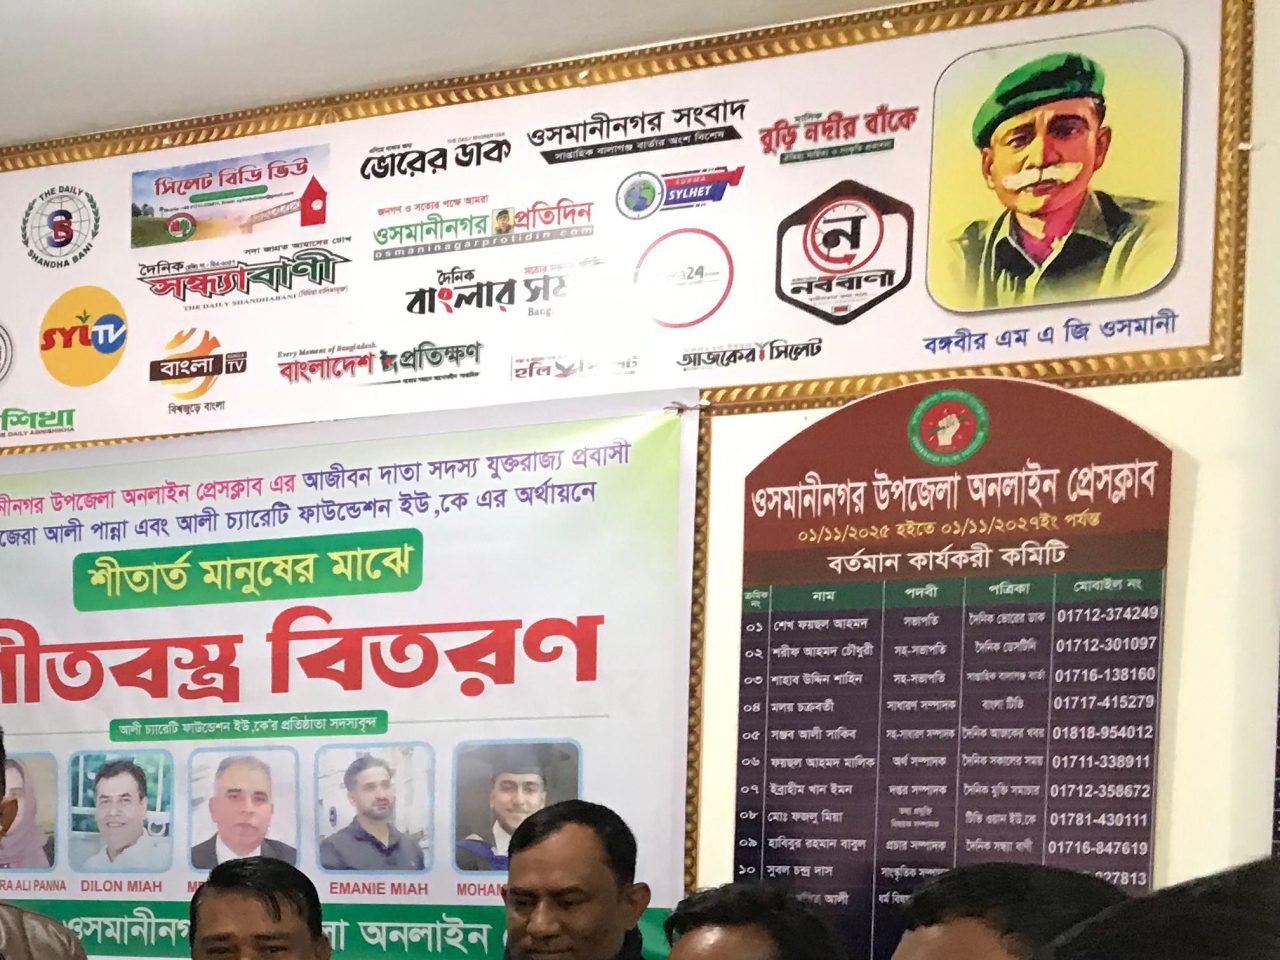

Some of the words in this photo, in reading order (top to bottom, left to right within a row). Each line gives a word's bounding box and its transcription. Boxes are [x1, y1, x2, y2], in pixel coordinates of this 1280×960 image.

[527, 111, 665, 147] ওসমানীনগর
[672, 99, 749, 128] সংবাদ
[804, 110, 859, 142] নদীর
[360, 147, 448, 180] ভোরের
[454, 139, 512, 167] ডাক
[155, 172, 213, 195] সিলেট
[217, 164, 262, 187] বিডি
[39, 187, 56, 201] THE
[59, 185, 83, 197] DAILY
[668, 185, 713, 201] SYLHET
[373, 212, 490, 246] ওসমানীনগর
[513, 198, 595, 231] প্রতিদিন
[822, 215, 867, 250] ন
[28, 249, 70, 268] SHANDHA
[72, 243, 94, 263] BANI
[139, 261, 185, 277] দৈনিক
[437, 266, 476, 285] দৈনিক
[406, 278, 518, 314] বাংলার
[923, 329, 987, 355] বঙ্গবীর
[994, 327, 1029, 349] এম
[1037, 326, 1055, 345] এ
[1063, 318, 1092, 342] জি
[1100, 308, 1179, 338] ওসমানী
[769, 337, 823, 360] সিলেট
[159, 357, 216, 377] বাংলা
[227, 360, 244, 372] TV
[277, 352, 377, 386] বাংলাদেশ
[50, 489, 117, 511] উপজেলা
[121, 481, 191, 507] অনলাইন
[197, 476, 264, 500] প্রেসক্লাব
[270, 474, 296, 494] এর
[302, 462, 372, 490] আজীবন
[378, 462, 421, 484] দাতা
[428, 457, 480, 482] সদস্য
[485, 449, 565, 482] যুক্তরাজ্য
[571, 438, 632, 468] প্রবাসী
[751, 470, 867, 520] ওসমানীনগর
[871, 468, 962, 514] উপজেলা
[966, 458, 1061, 510] অনলাইন
[1066, 459, 1159, 505] প্রেসক্লাব
[43, 518, 83, 543] আলী
[90, 520, 129, 542] পান্না
[134, 518, 171, 538] এবং
[176, 508, 219, 534] আলী
[226, 501, 291, 532] চ্যারেটি
[297, 499, 391, 527] ফাউন্ডেশন
[477, 488, 506, 508] এর
[514, 477, 598, 505] অর্থায়নে
[798, 524, 891, 545] ০১/১১/২০২৫
[827, 547, 901, 575] বর্তমান
[907, 542, 994, 571] কার্যকরী
[1000, 538, 1070, 568] কমিটি
[87, 551, 193, 600] শীতার্ত
[199, 550, 320, 599] মানুষের
[326, 543, 415, 583] মাঝে
[812, 590, 837, 602] নাম
[904, 583, 939, 599] পদবী
[1056, 605, 1159, 623] 01712-374249
[265, 605, 605, 698] বিতরণ
[1055, 637, 1158, 653] 01712-301097
[1054, 667, 1156, 683] 01716-138160
[1053, 694, 1155, 710] 01717-415279
[119, 720, 142, 736] আলী
[144, 719, 178, 736] চ্যারেটি
[1052, 724, 1154, 740] 01818-954012
[1051, 755, 1150, 769] 01711-338911
[1049, 784, 1151, 799] 01712-358672
[1049, 812, 1149, 827] 01781-430111
[1047, 840, 1149, 855] 01716-847619
[15, 880, 32, 891] ALI
[33, 879, 66, 891] PANNA
[80, 879, 124, 893] DILON
[127, 879, 163, 893] MIAH
[328, 882, 387, 897] EMANIE
[389, 882, 430, 898] MIAH
[356, 912, 494, 956] অনলাইন
